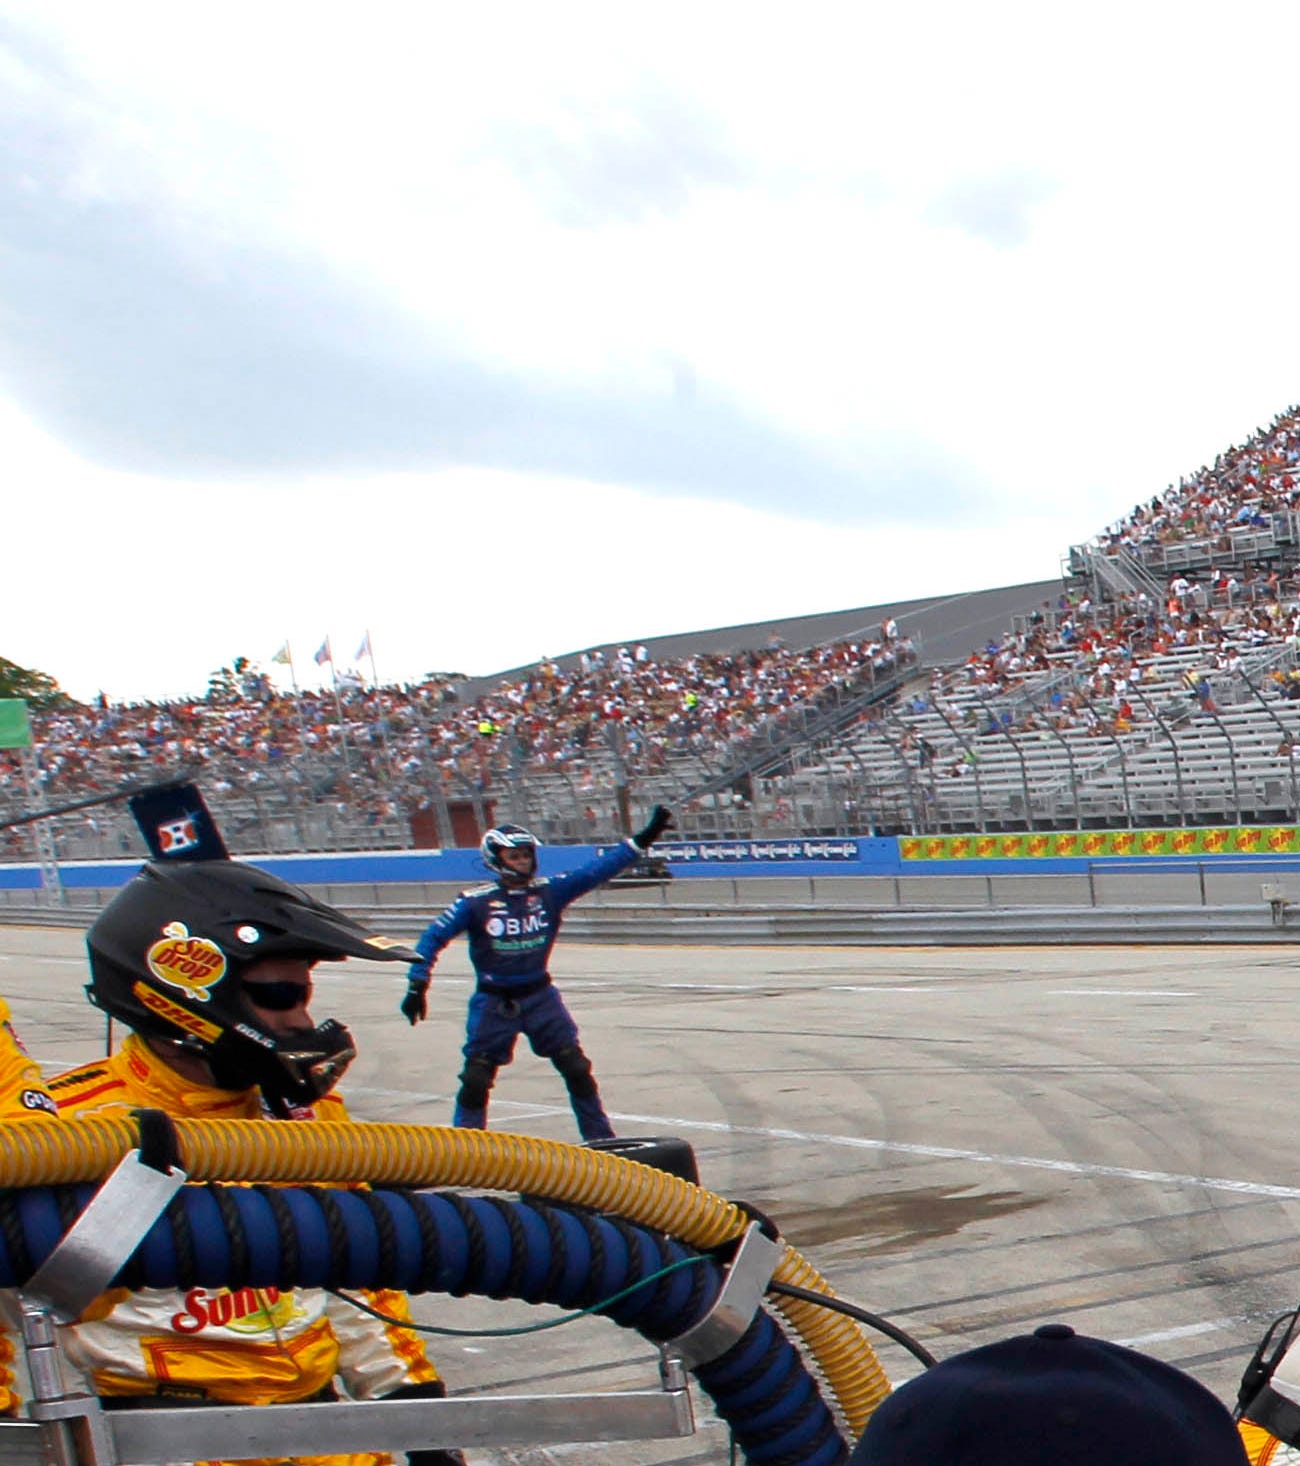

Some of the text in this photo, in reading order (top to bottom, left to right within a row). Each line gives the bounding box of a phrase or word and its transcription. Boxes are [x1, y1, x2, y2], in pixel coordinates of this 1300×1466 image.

[507, 910, 549, 935] BMC
[153, 946, 212, 980] Drop
[175, 941, 224, 968] Sun
[143, 993, 209, 1031] DHL
[171, 1286, 260, 1334] Sun
